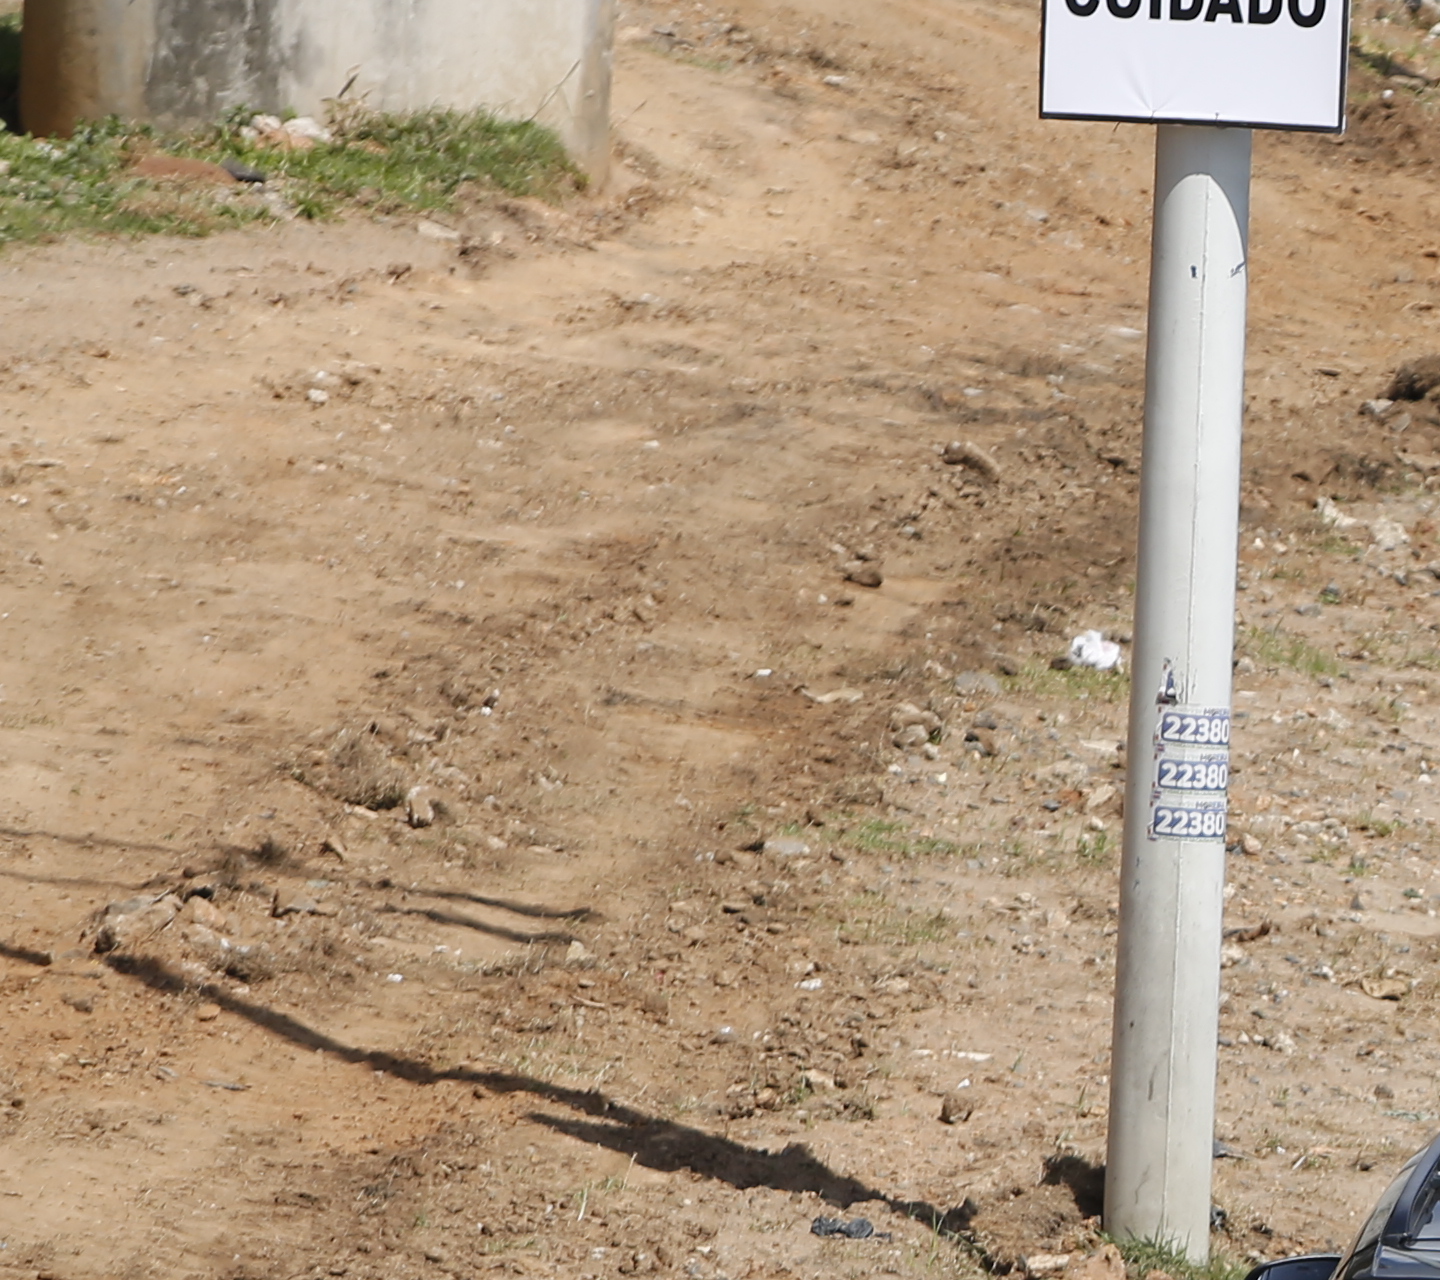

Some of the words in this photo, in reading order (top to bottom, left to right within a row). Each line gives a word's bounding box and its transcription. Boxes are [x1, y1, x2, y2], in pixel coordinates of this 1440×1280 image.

[1163, 715, 1230, 744] 22380
[1160, 761, 1227, 789] 22380
[1155, 808, 1225, 836] 22380
